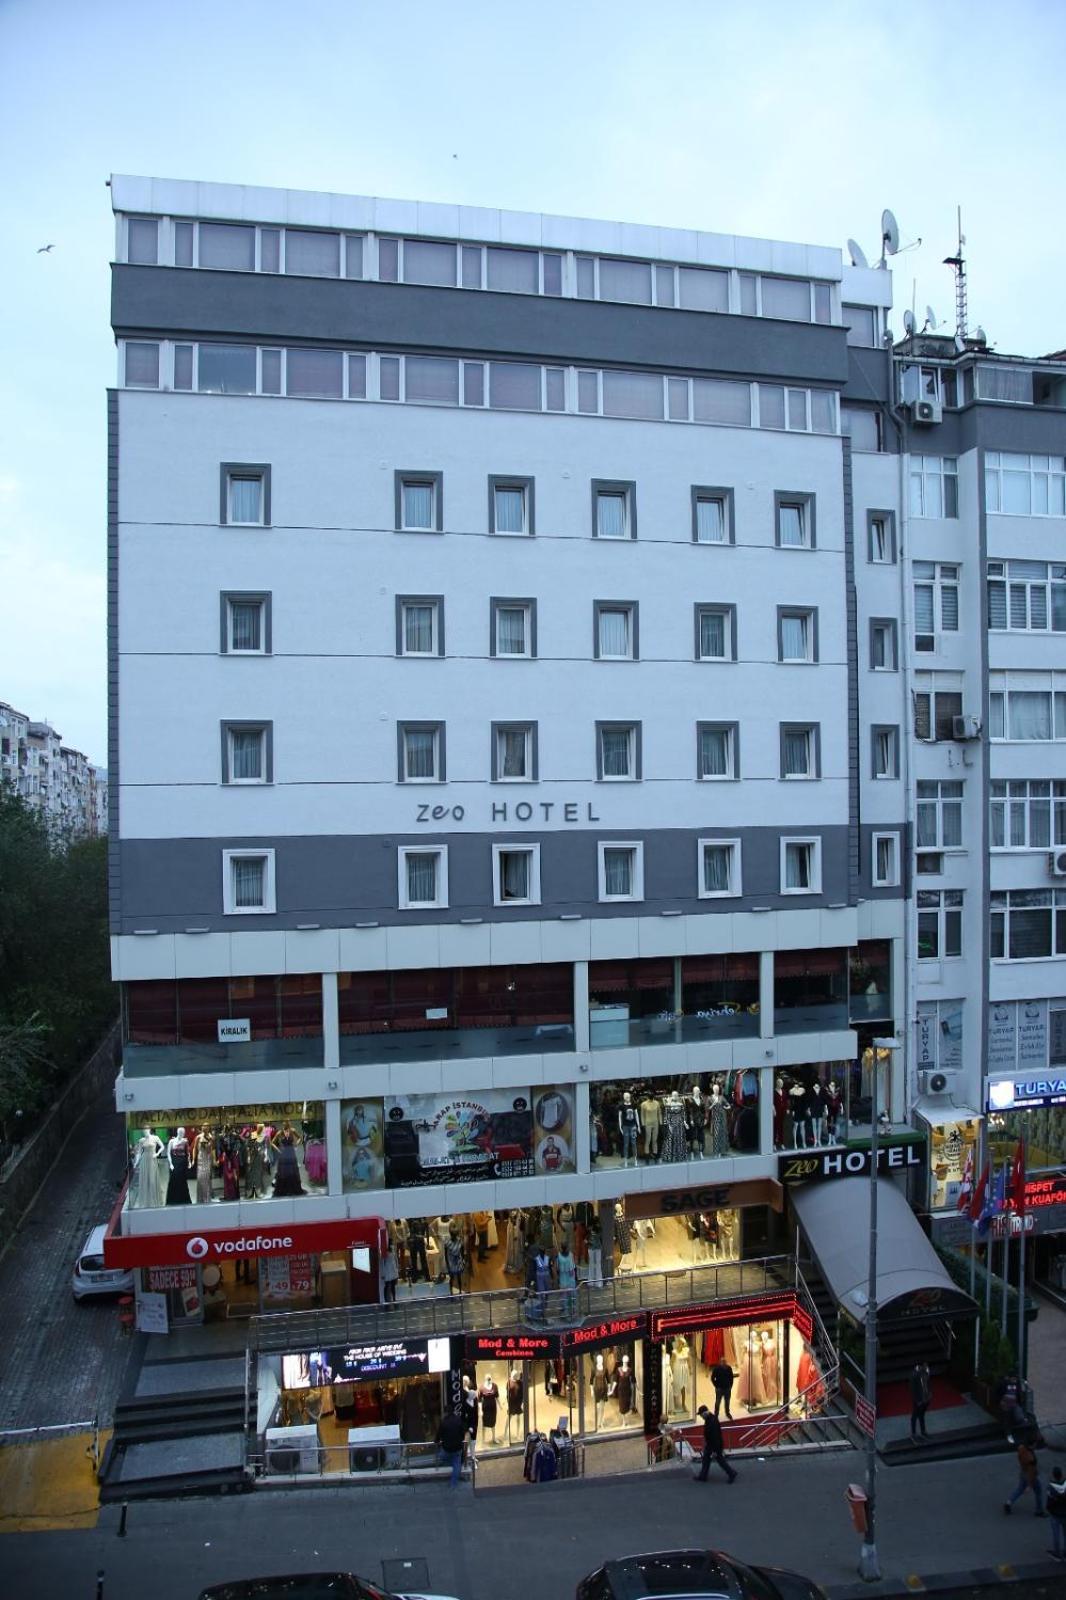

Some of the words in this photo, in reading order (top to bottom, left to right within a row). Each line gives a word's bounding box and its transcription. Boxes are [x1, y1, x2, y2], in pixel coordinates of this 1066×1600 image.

[492, 802, 600, 822] HOTEL
[220, 1026, 248, 1036] KİRALIK
[921, 1018, 929, 1061] TURYAP
[823, 1146, 920, 1175] HOTEL
[213, 1236, 293, 1254] vodafone
[150, 1271, 179, 1290] SADECE
[574, 1329, 597, 1343] Mod
[600, 1326, 608, 1337] &
[611, 1319, 637, 1333] More
[478, 1338, 502, 1349] Mod
[506, 1338, 516, 1348] &
[519, 1338, 549, 1348] More
